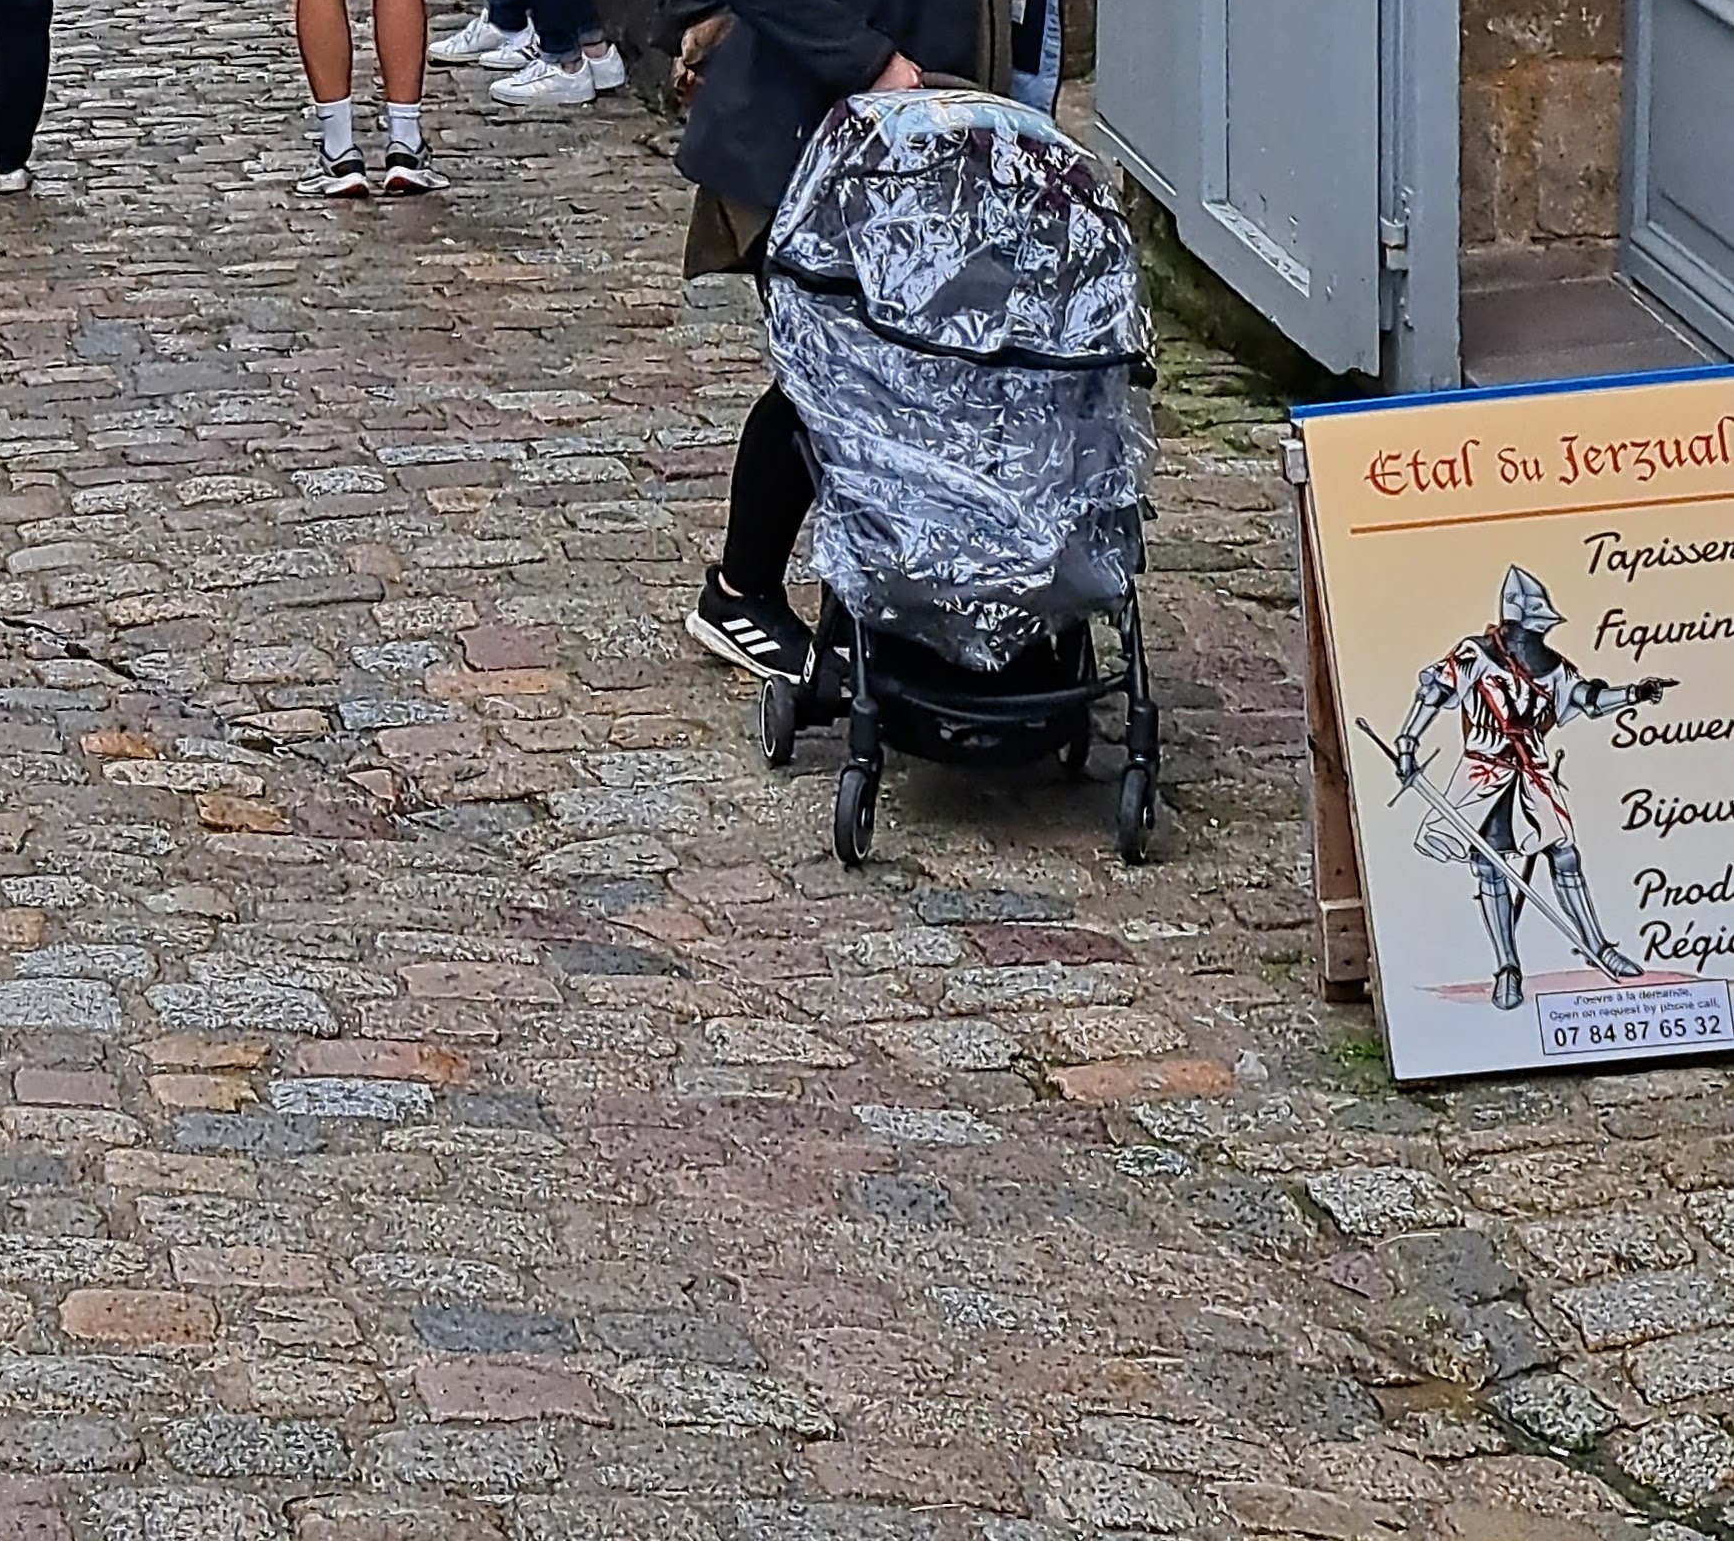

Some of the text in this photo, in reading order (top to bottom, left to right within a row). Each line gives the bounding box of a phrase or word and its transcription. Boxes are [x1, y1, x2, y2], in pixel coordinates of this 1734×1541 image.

[1364, 415, 1734, 496] Etal du Jerzual
[1593, 608, 1734, 663] Figurin
[1549, 1007, 1579, 1022] Open
[1582, 1009, 1596, 1018] on
[1598, 1005, 1641, 1017] request
[1643, 1003, 1656, 1015] by
[1554, 1015, 1722, 1047] 07 84 87 65 32
